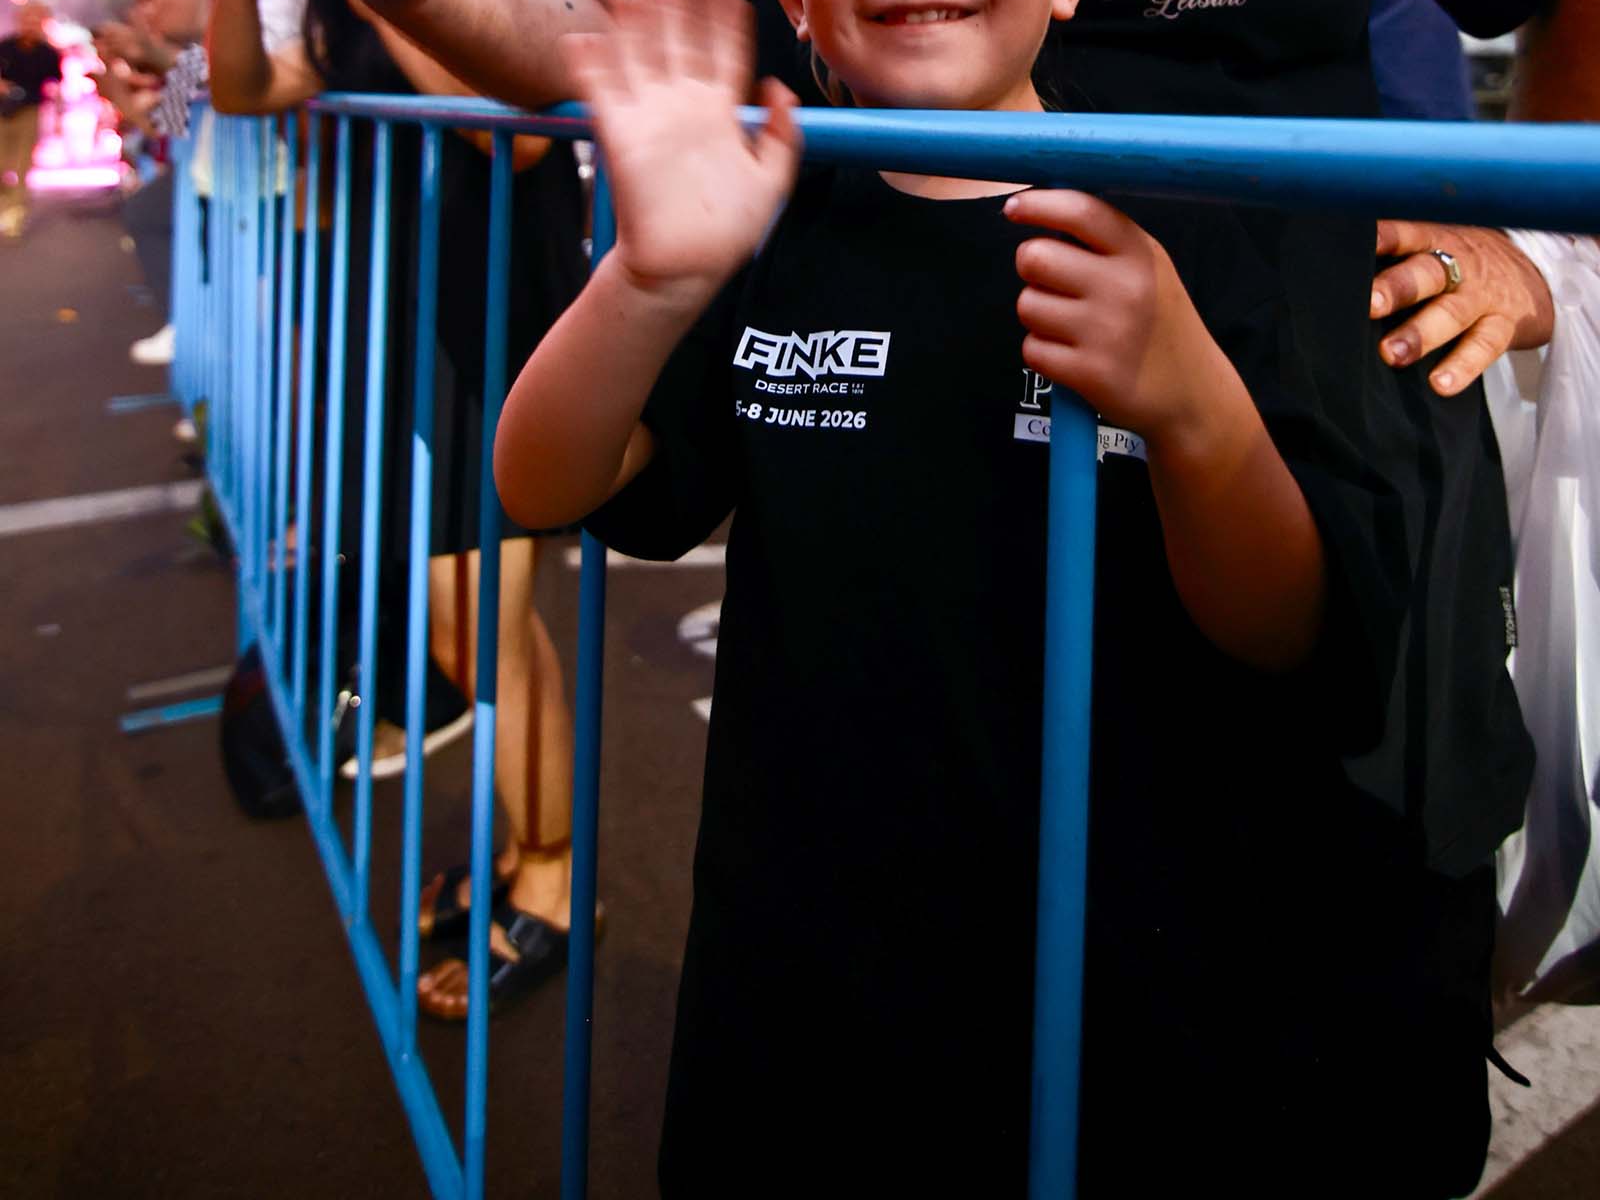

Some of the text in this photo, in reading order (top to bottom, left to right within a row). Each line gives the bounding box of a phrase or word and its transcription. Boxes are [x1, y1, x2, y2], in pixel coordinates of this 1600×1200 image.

[733, 326, 891, 381] FINKE
[755, 379, 810, 395] DESERT
[812, 382, 849, 395] RACE
[765, 407, 816, 427] JUNE
[820, 410, 867, 429] 2026
[1114, 432, 1139, 453] Pty
